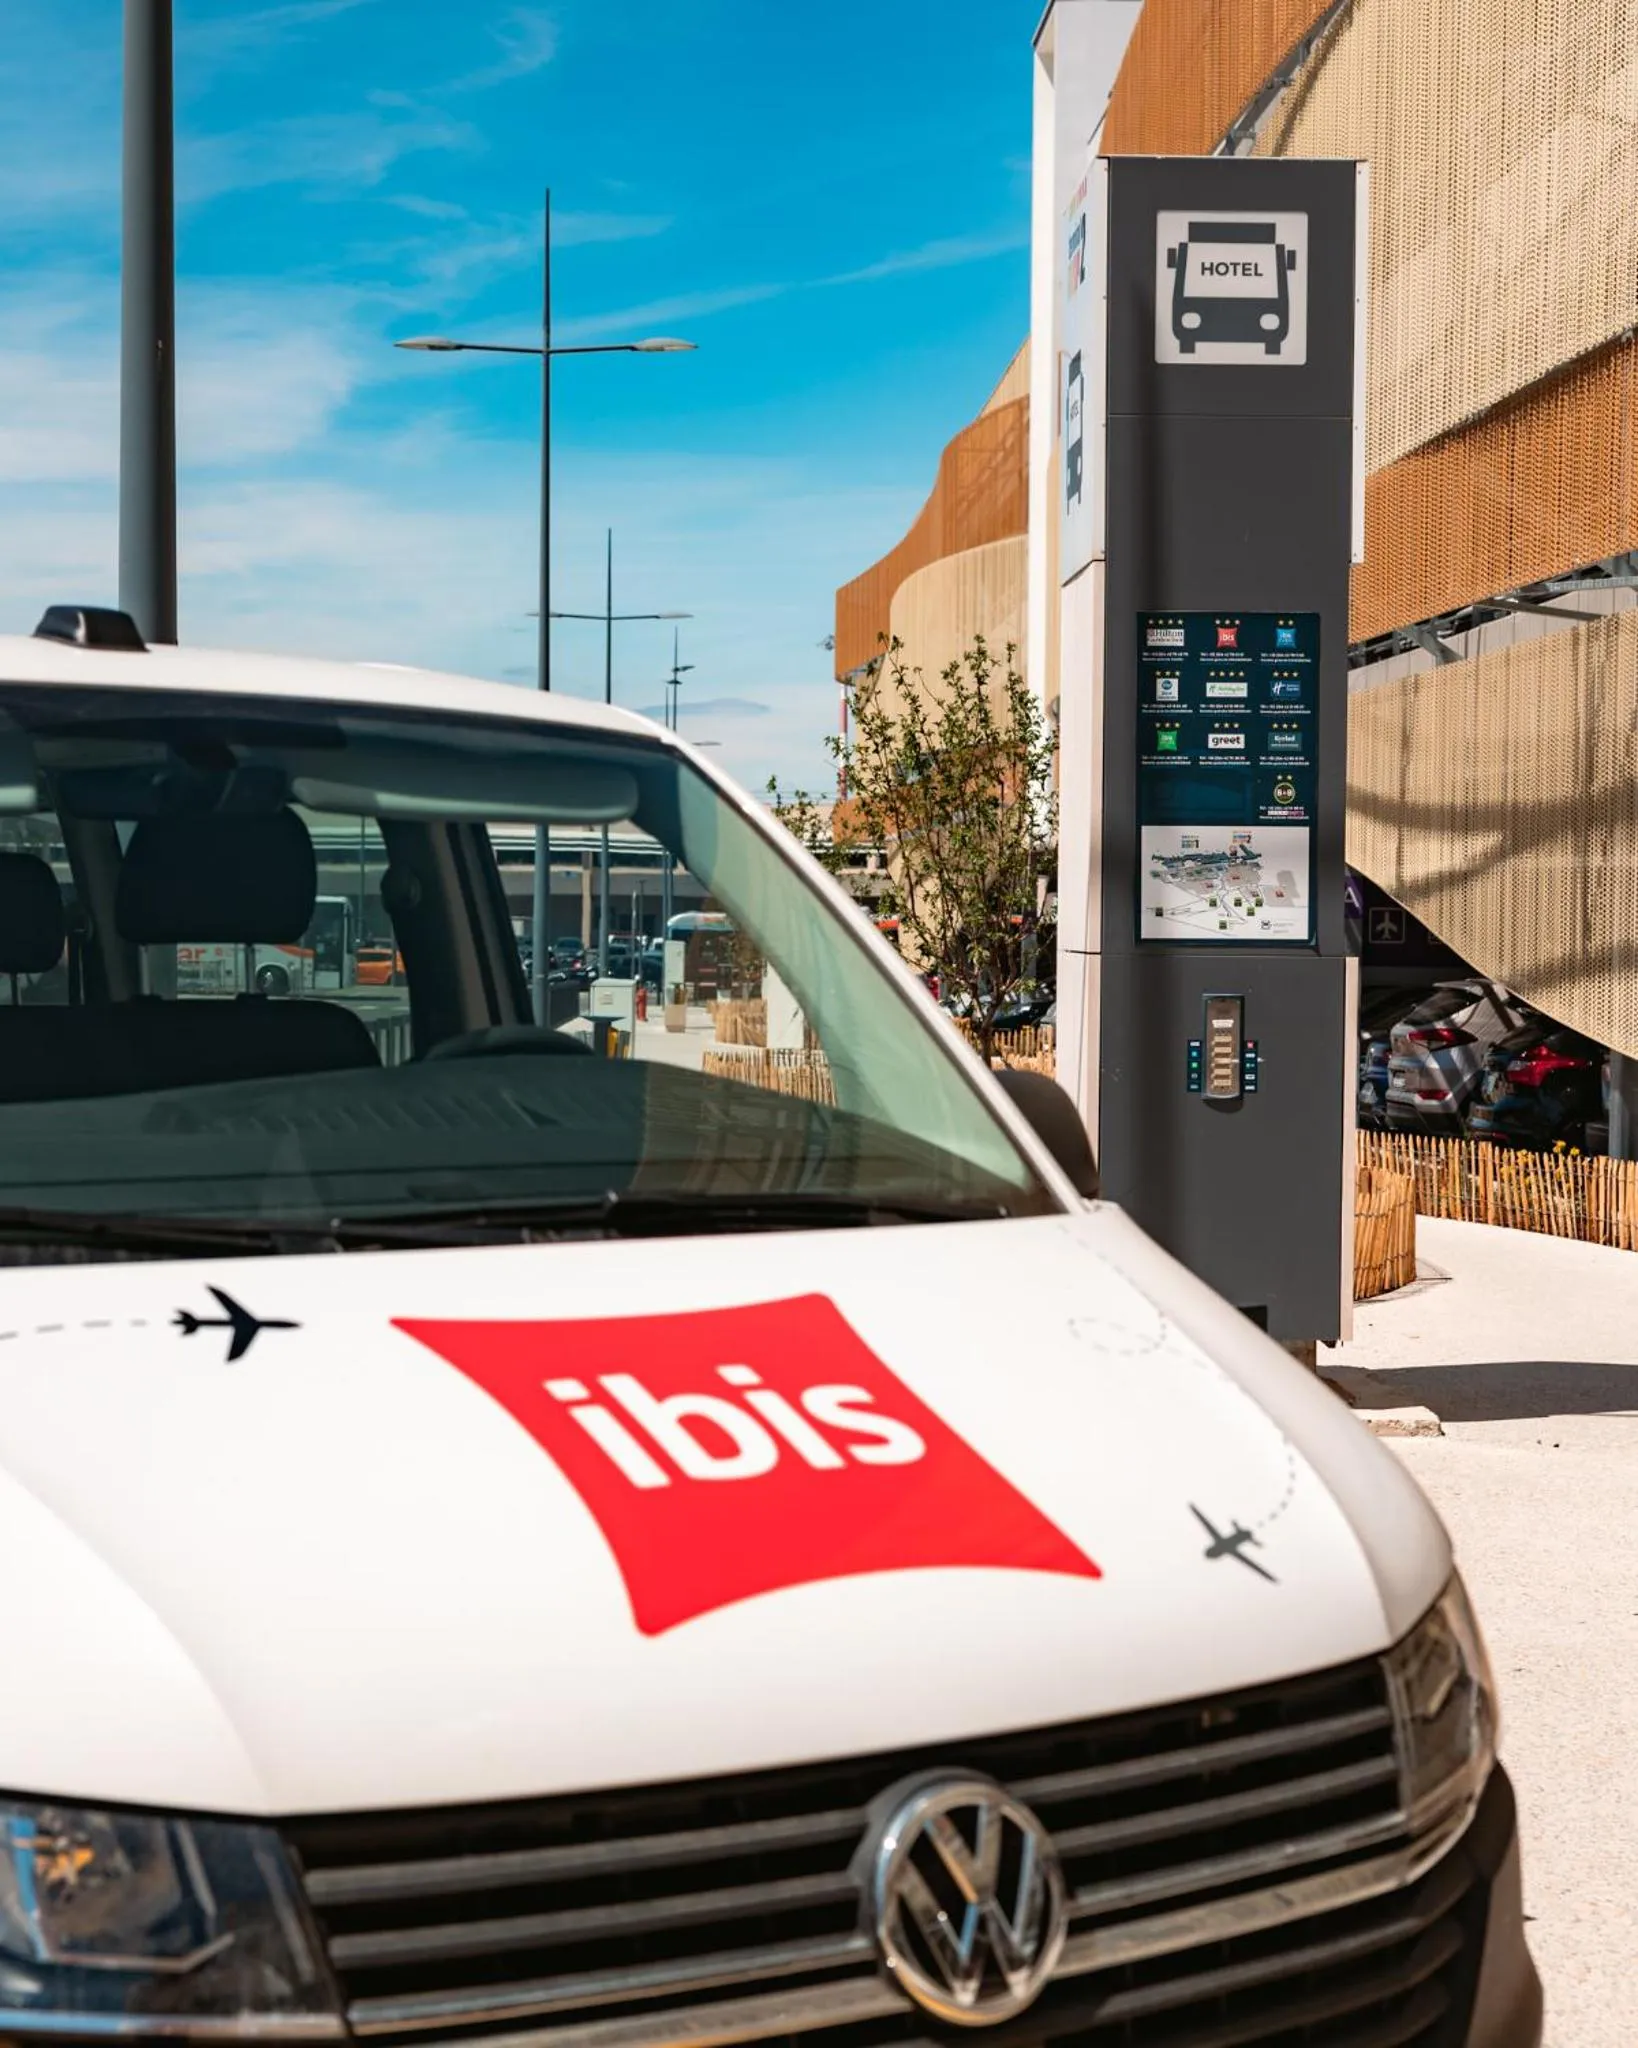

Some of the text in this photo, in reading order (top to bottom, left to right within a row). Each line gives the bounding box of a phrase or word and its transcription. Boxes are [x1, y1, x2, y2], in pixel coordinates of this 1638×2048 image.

[1201, 262, 1264, 277] HOTEL
[1211, 736, 1241, 746] greet
[541, 1364, 927, 1490] ibis
